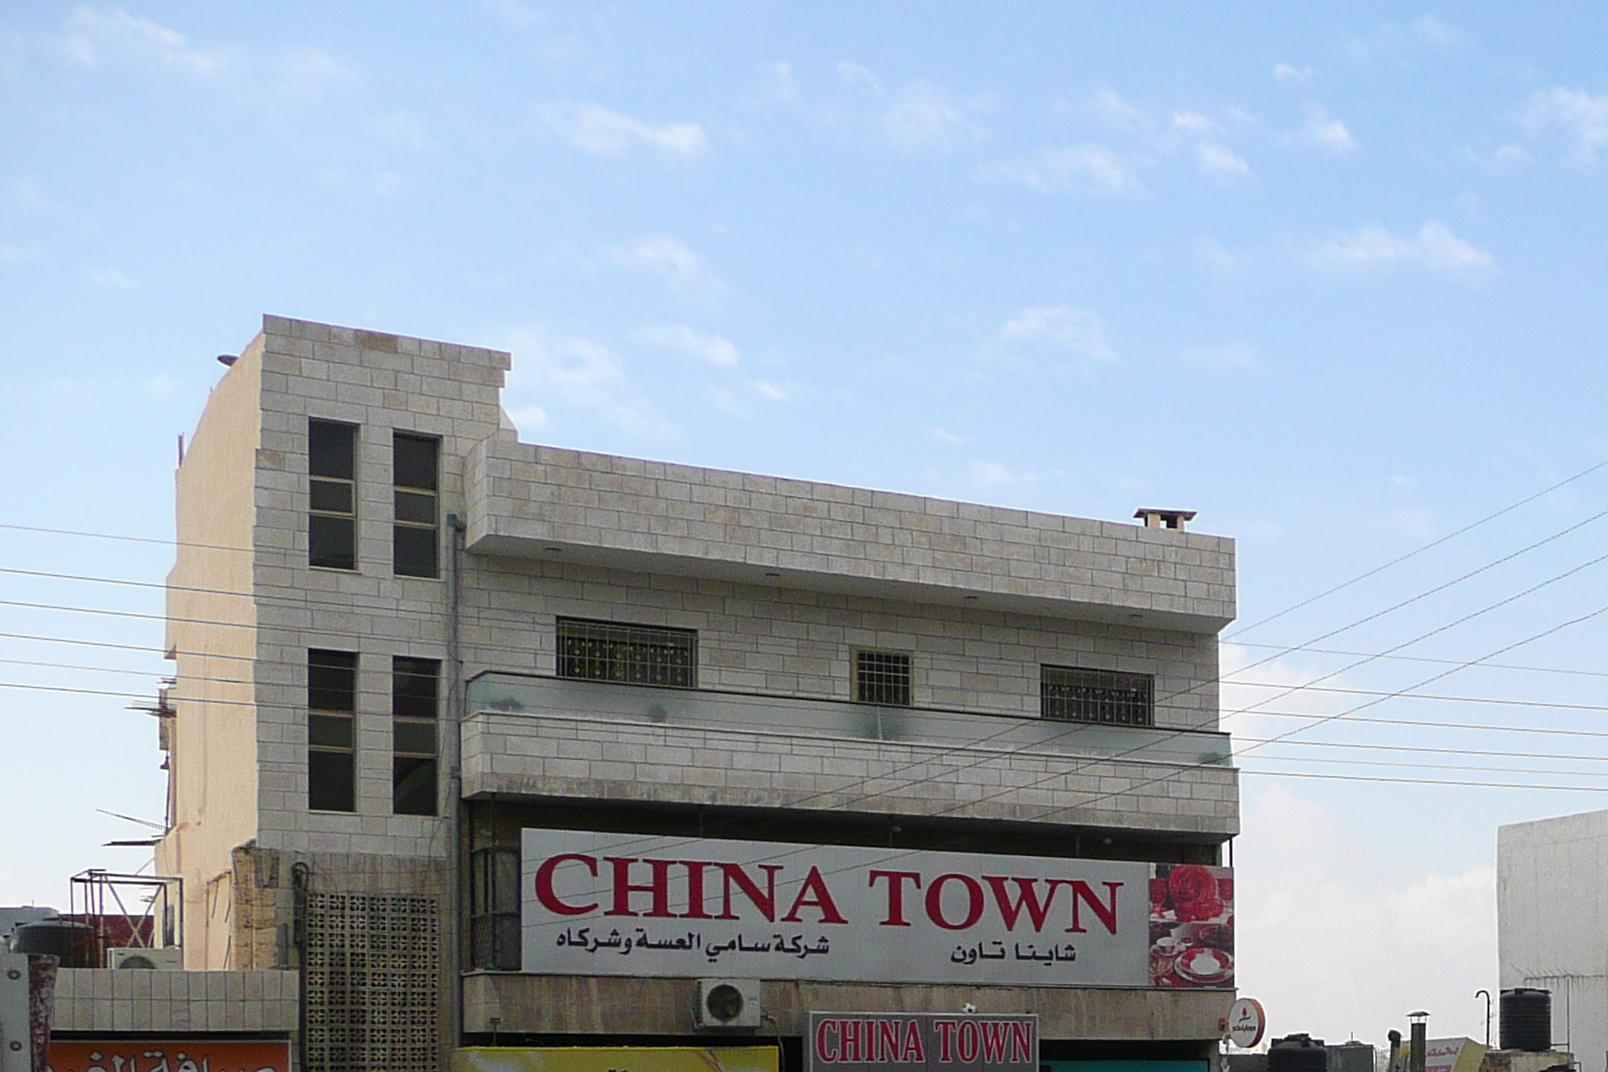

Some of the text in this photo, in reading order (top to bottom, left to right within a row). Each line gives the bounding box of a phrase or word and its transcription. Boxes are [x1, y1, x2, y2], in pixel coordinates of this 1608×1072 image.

[535, 853, 1124, 935] CHINA TOWN
[556, 927, 634, 955] وشركاه
[706, 934, 771, 963] سامي
[775, 933, 830, 958] شركة
[951, 941, 1076, 966] شاينا تاون
[816, 1019, 1033, 1064] CHINA TOWN
